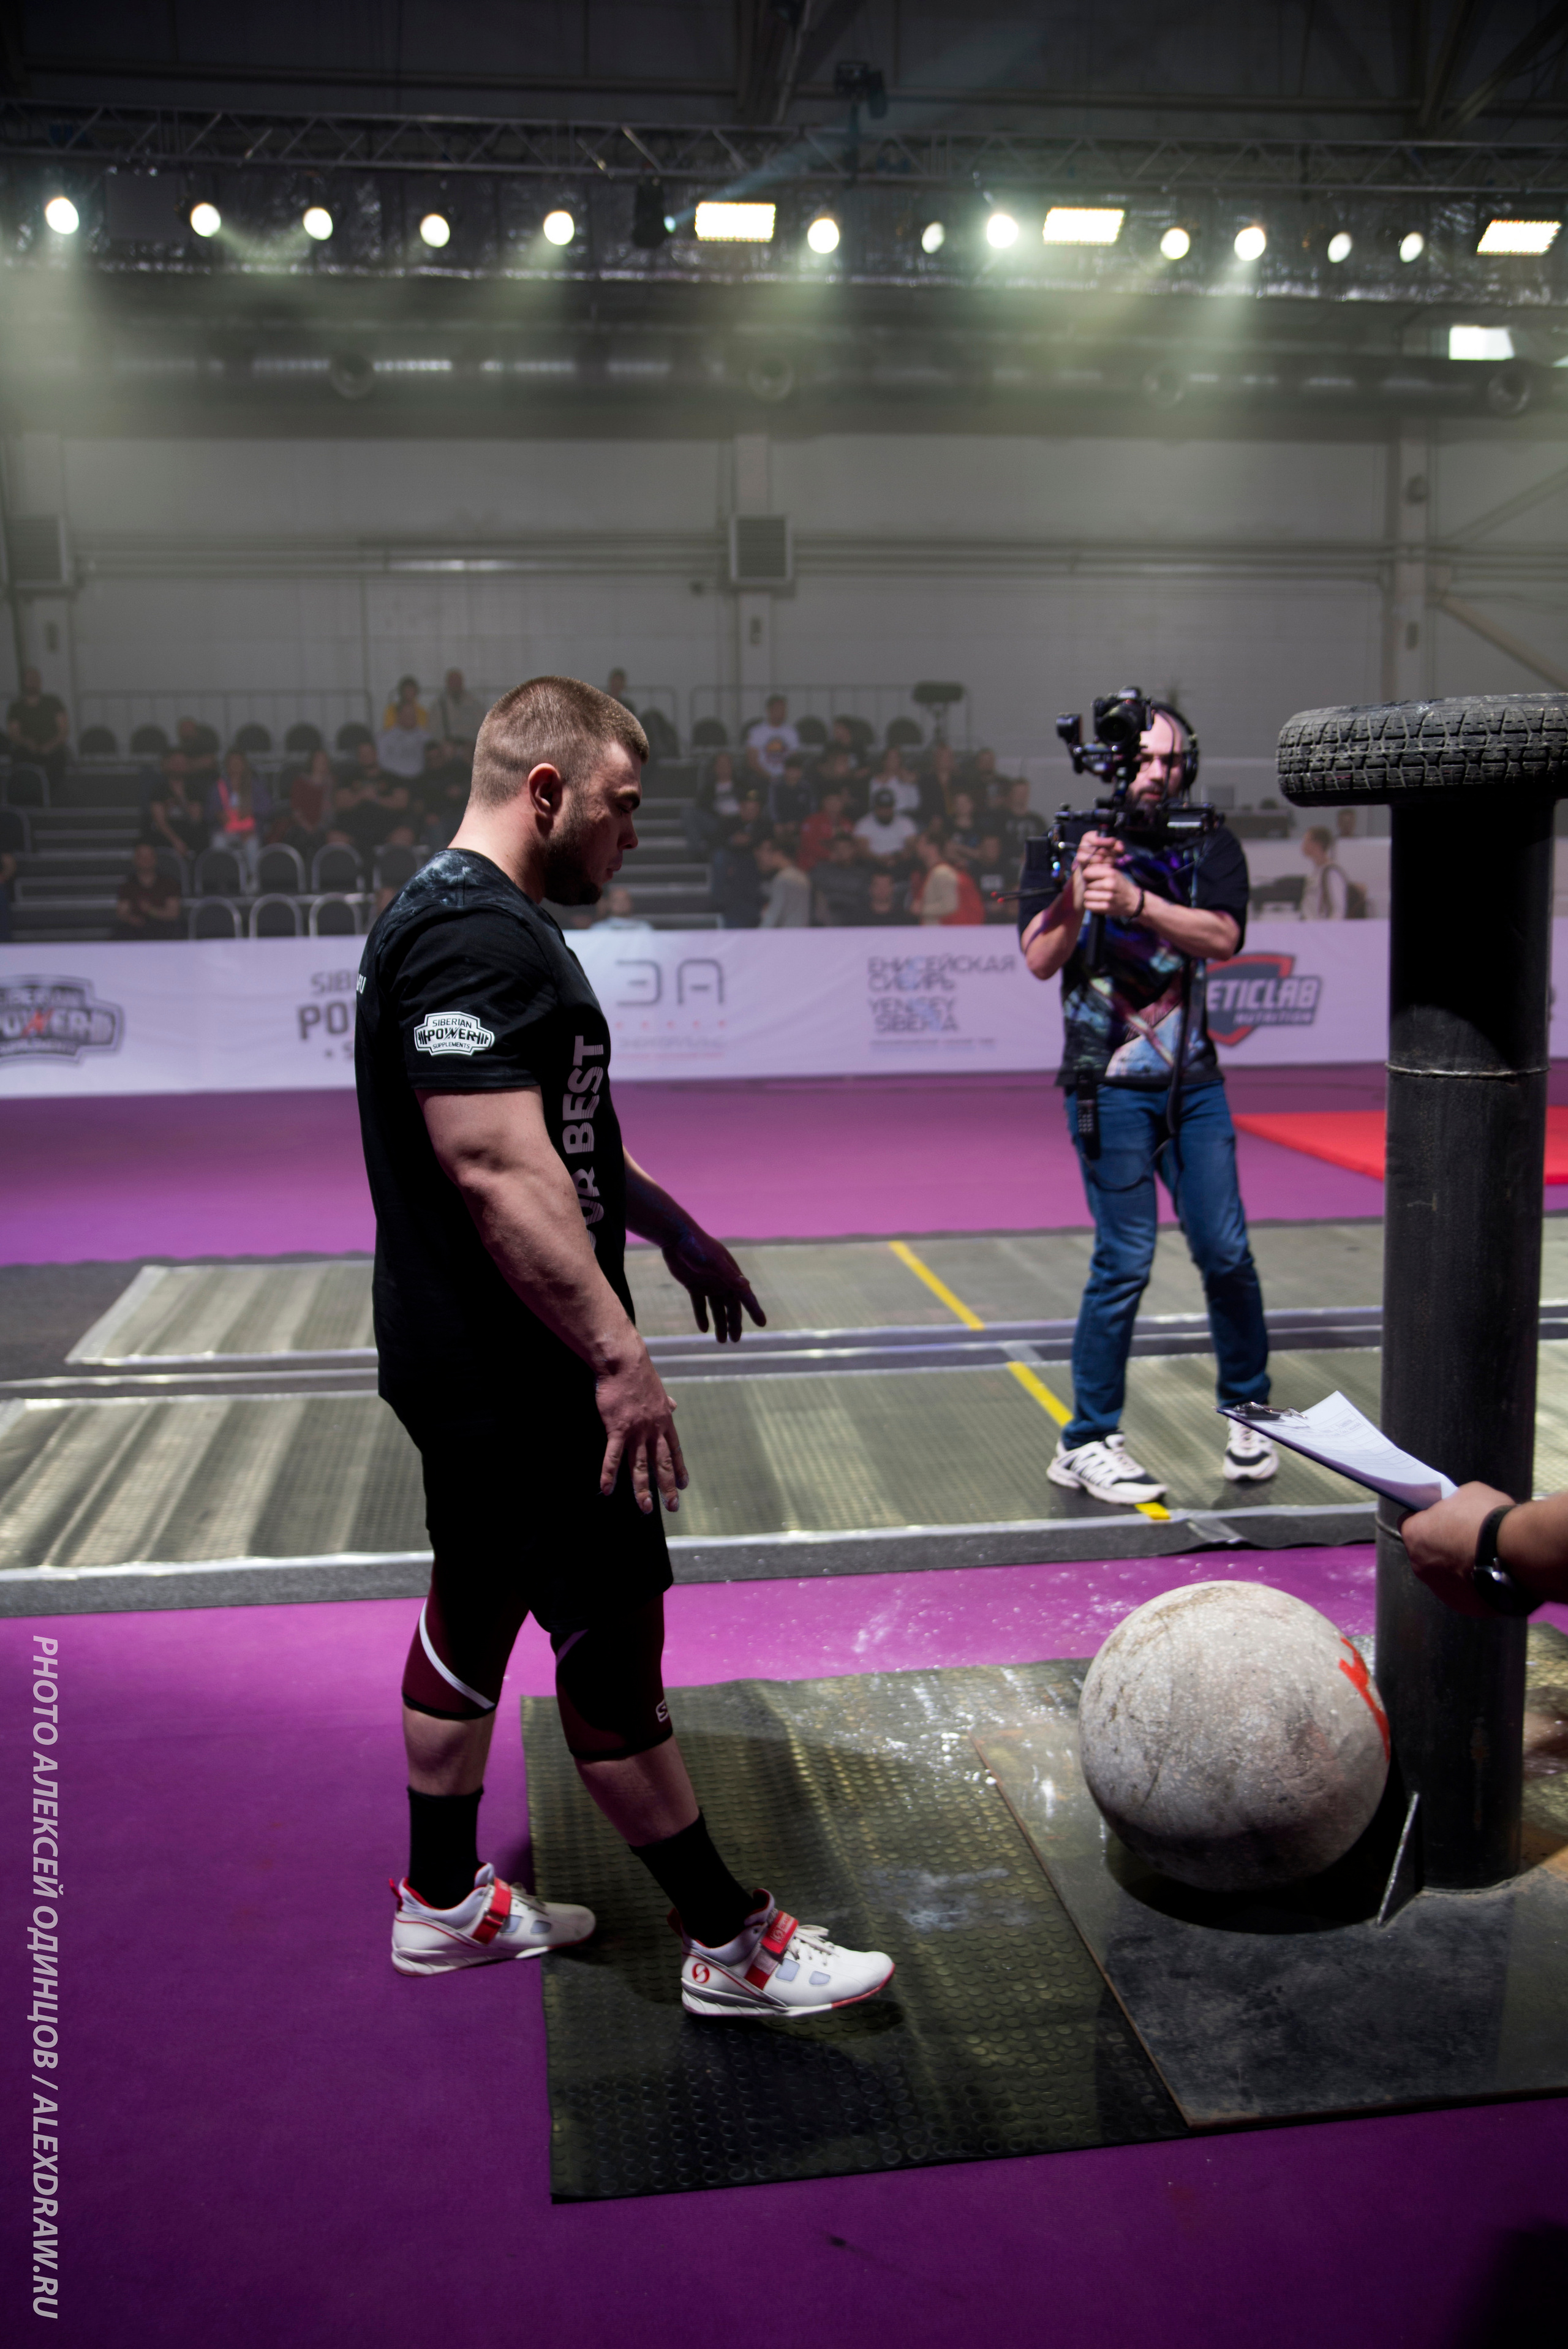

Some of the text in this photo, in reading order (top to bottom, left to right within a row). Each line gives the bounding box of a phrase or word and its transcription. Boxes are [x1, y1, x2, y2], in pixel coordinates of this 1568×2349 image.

[299, 1001, 356, 1039] PO
[432, 1018, 472, 1028] SIBERIAN
[428, 1027, 476, 1041] POWER
[562, 1035, 604, 1154] BEST
